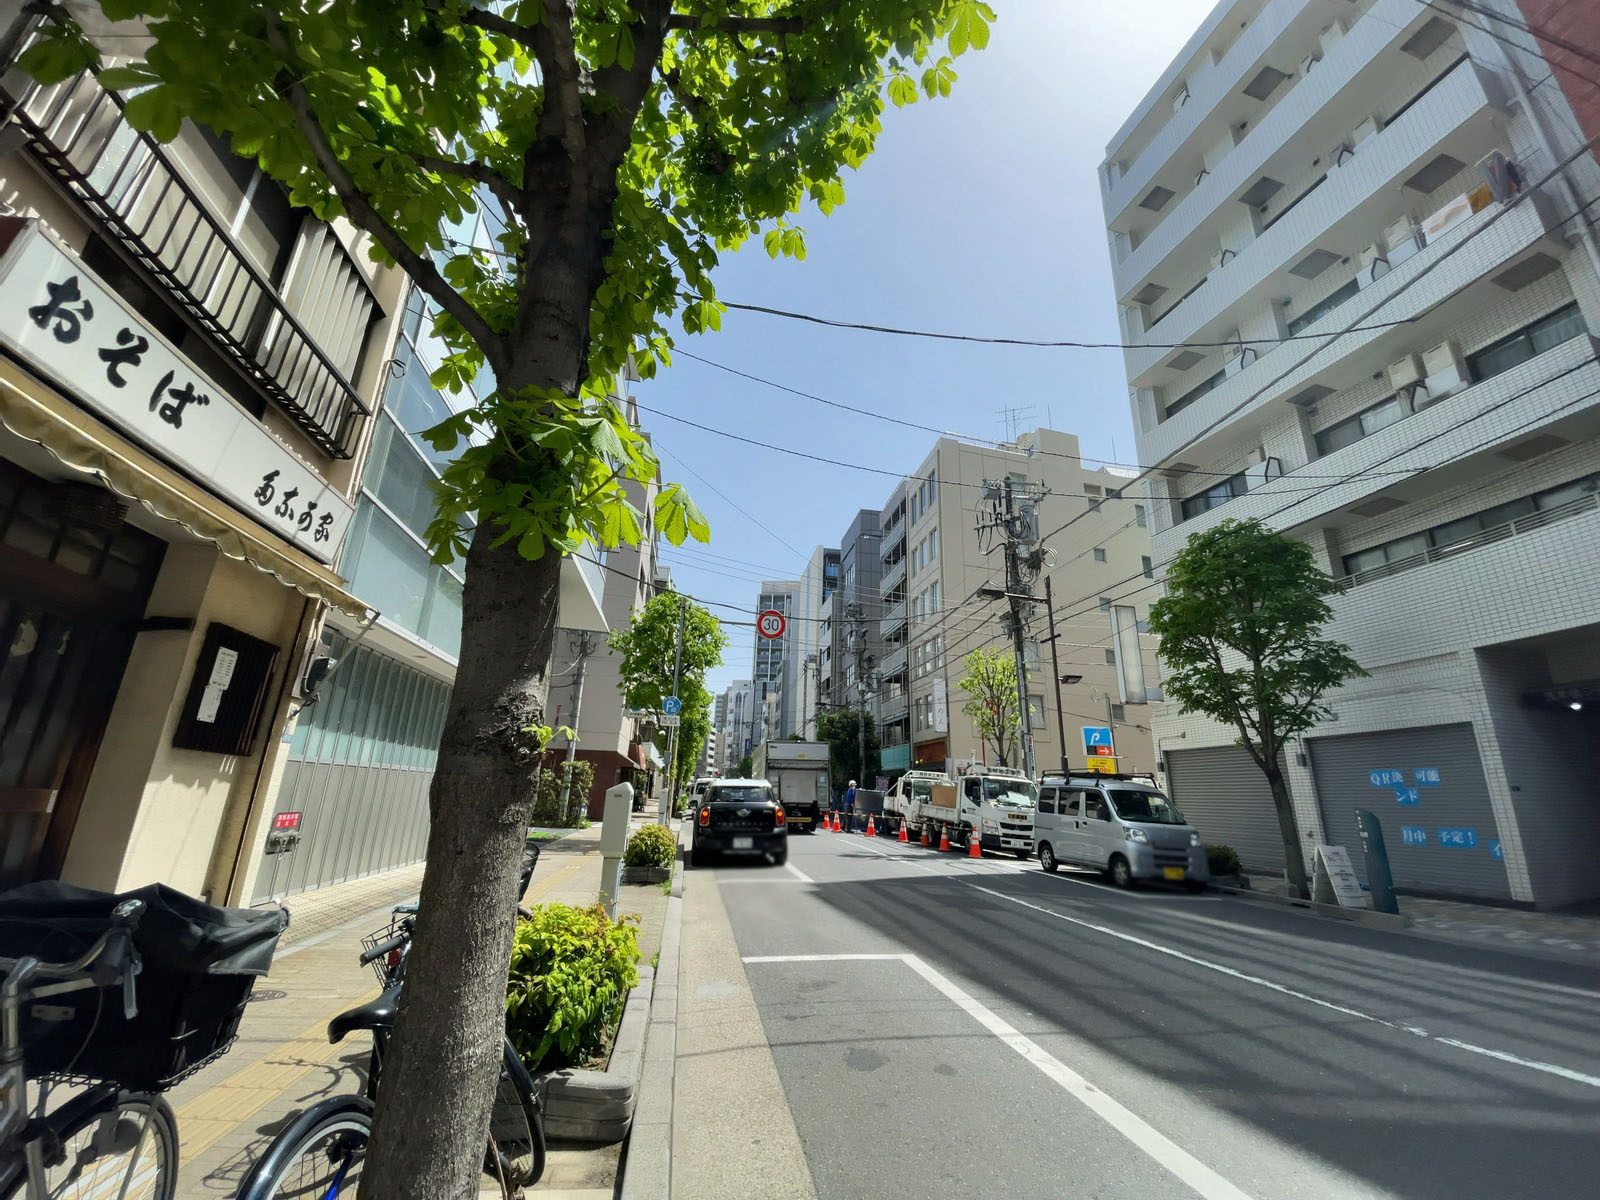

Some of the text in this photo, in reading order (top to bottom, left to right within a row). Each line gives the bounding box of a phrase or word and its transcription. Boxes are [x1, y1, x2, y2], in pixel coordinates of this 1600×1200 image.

[28, 275, 210, 430] おそば
[763, 618, 779, 631] 30
[1415, 770, 1440, 782] 可能
